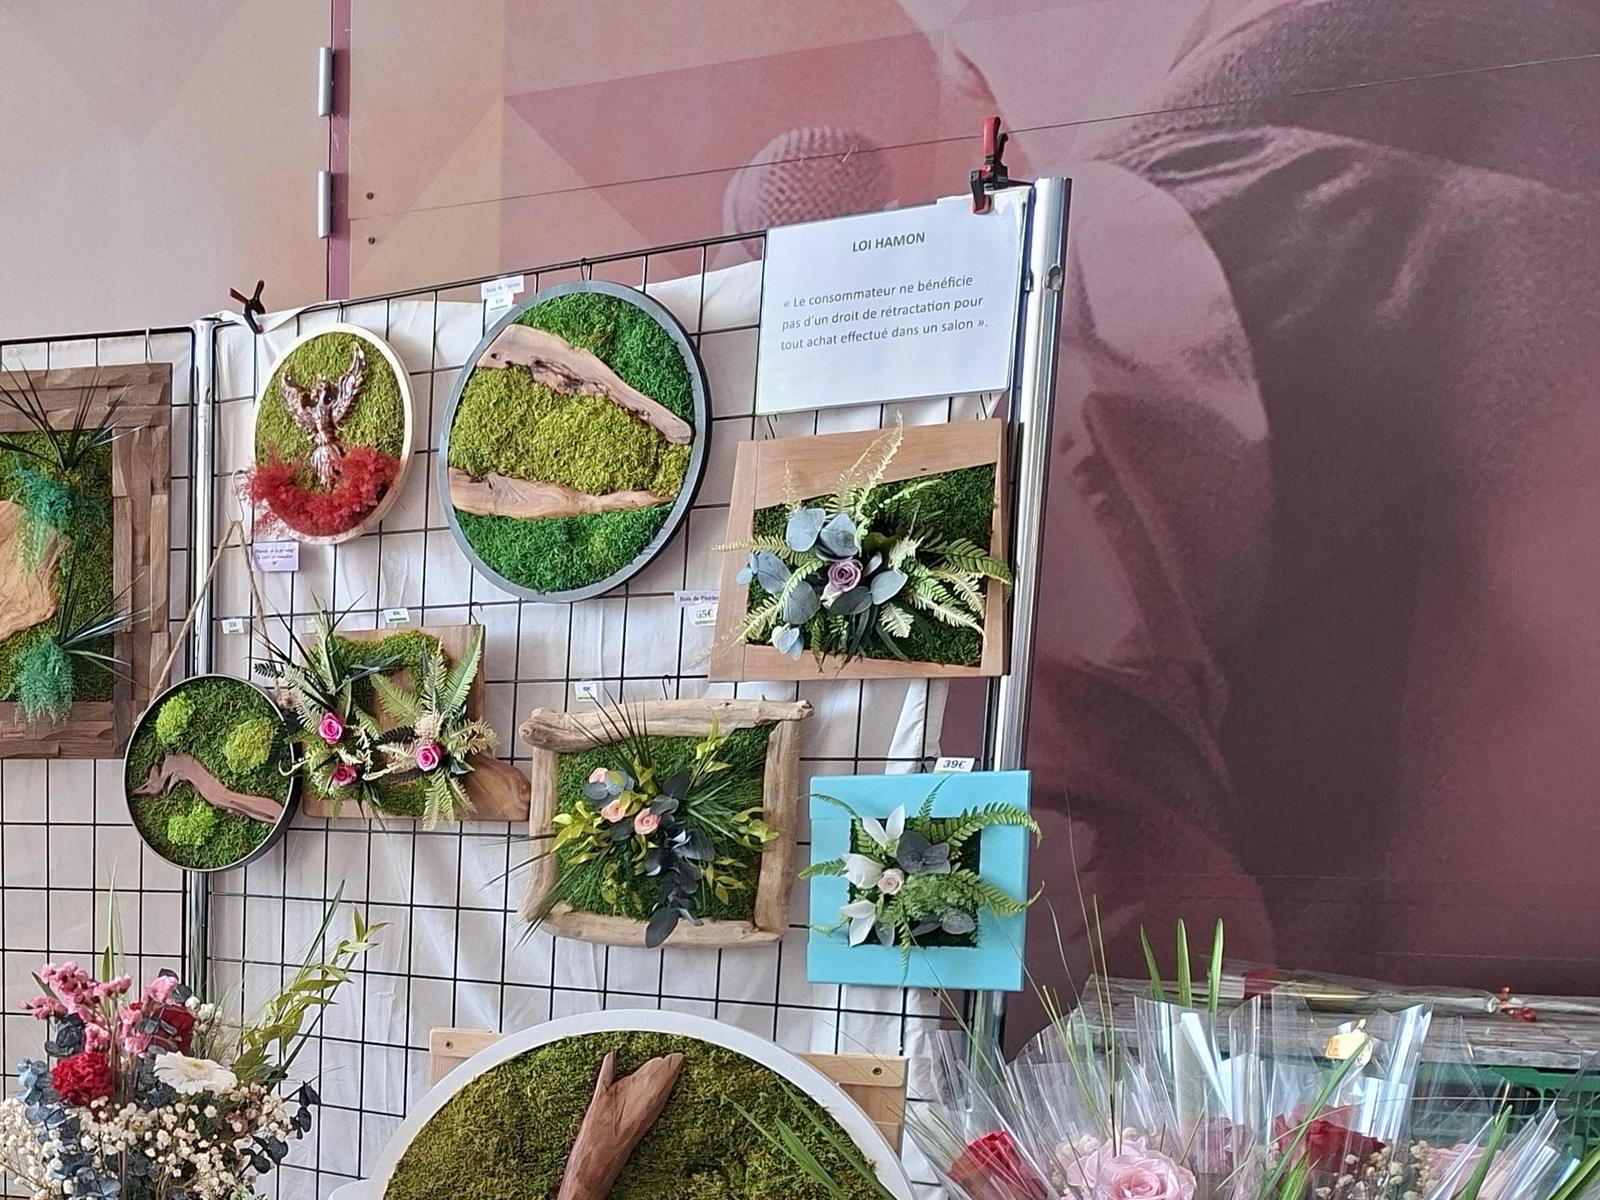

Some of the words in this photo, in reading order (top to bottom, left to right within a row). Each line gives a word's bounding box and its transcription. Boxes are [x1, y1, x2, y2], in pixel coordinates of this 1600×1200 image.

[852, 240, 872, 252] LOI
[875, 232, 926, 250] HAMON
[793, 297, 806, 309] Le
[808, 285, 896, 306] consommateur
[899, 282, 915, 294] ne
[917, 275, 974, 293] bénéficie
[782, 319, 801, 332] pas
[831, 309, 859, 324] droit
[862, 307, 878, 320] de
[880, 299, 951, 319] rétractation
[953, 296, 984, 315] pour
[781, 337, 804, 351] tout
[806, 334, 838, 348] achat
[840, 328, 889, 343] effectué
[891, 325, 920, 338] dans
[922, 323, 938, 334] un
[941, 318, 974, 333] salon
[943, 759, 967, 770] 39€
